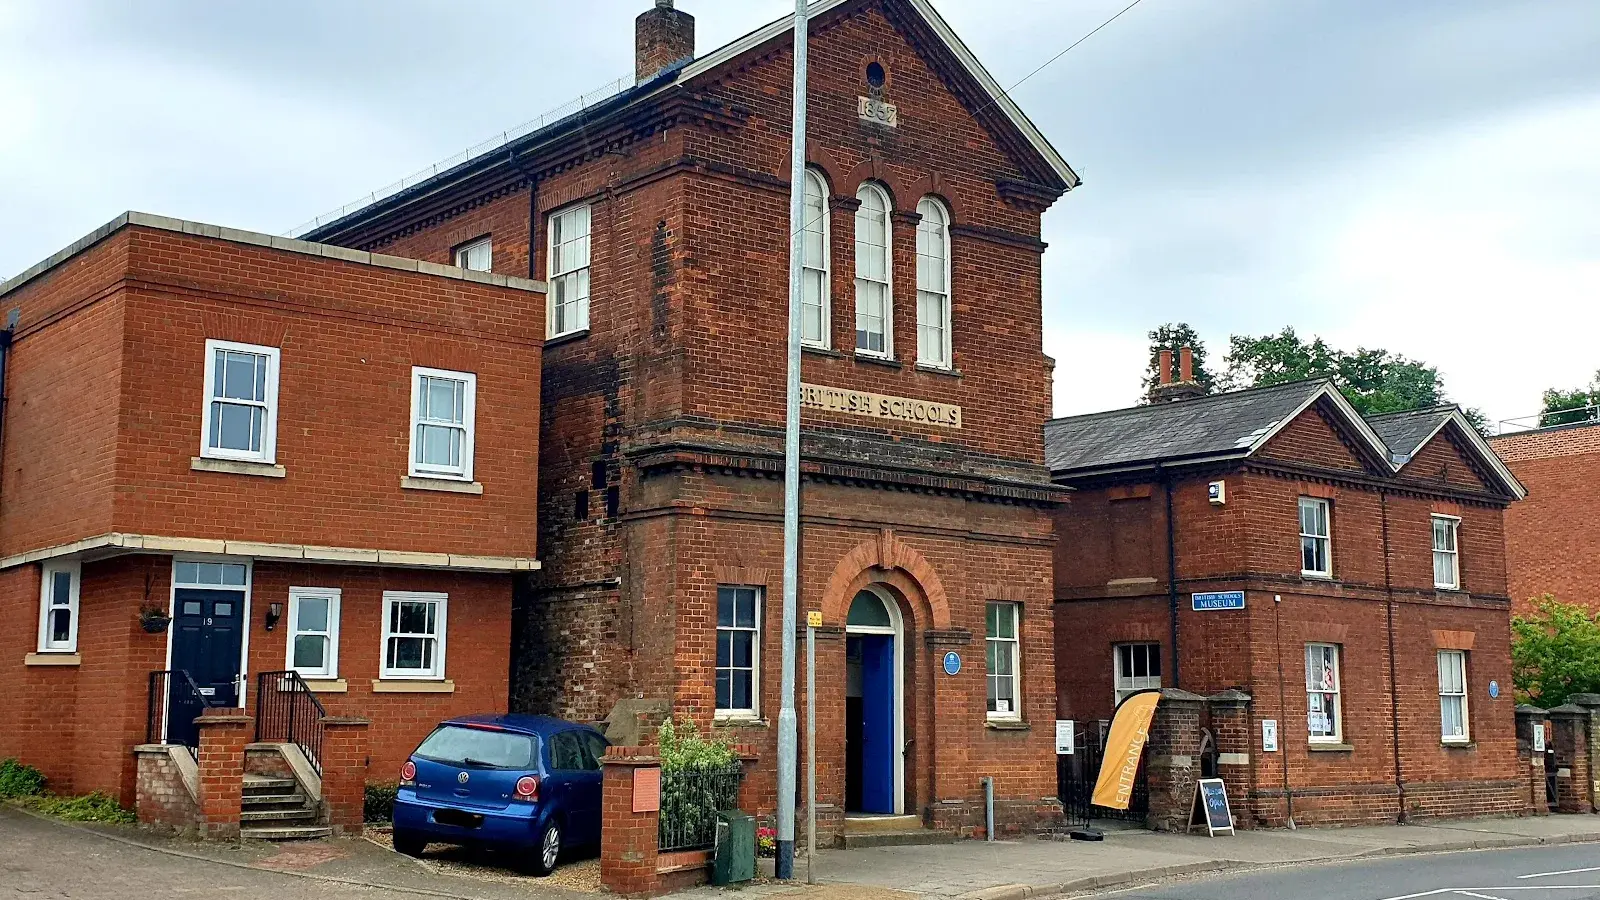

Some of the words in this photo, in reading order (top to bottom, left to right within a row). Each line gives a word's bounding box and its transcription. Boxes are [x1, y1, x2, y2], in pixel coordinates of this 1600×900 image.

[860, 99, 895, 123] 1857
[879, 399, 958, 426] SCHOOLS
[1200, 599, 1237, 608] MUSEUM
[203, 617, 213, 626] 19
[1115, 727, 1148, 804] ENTRANCE
